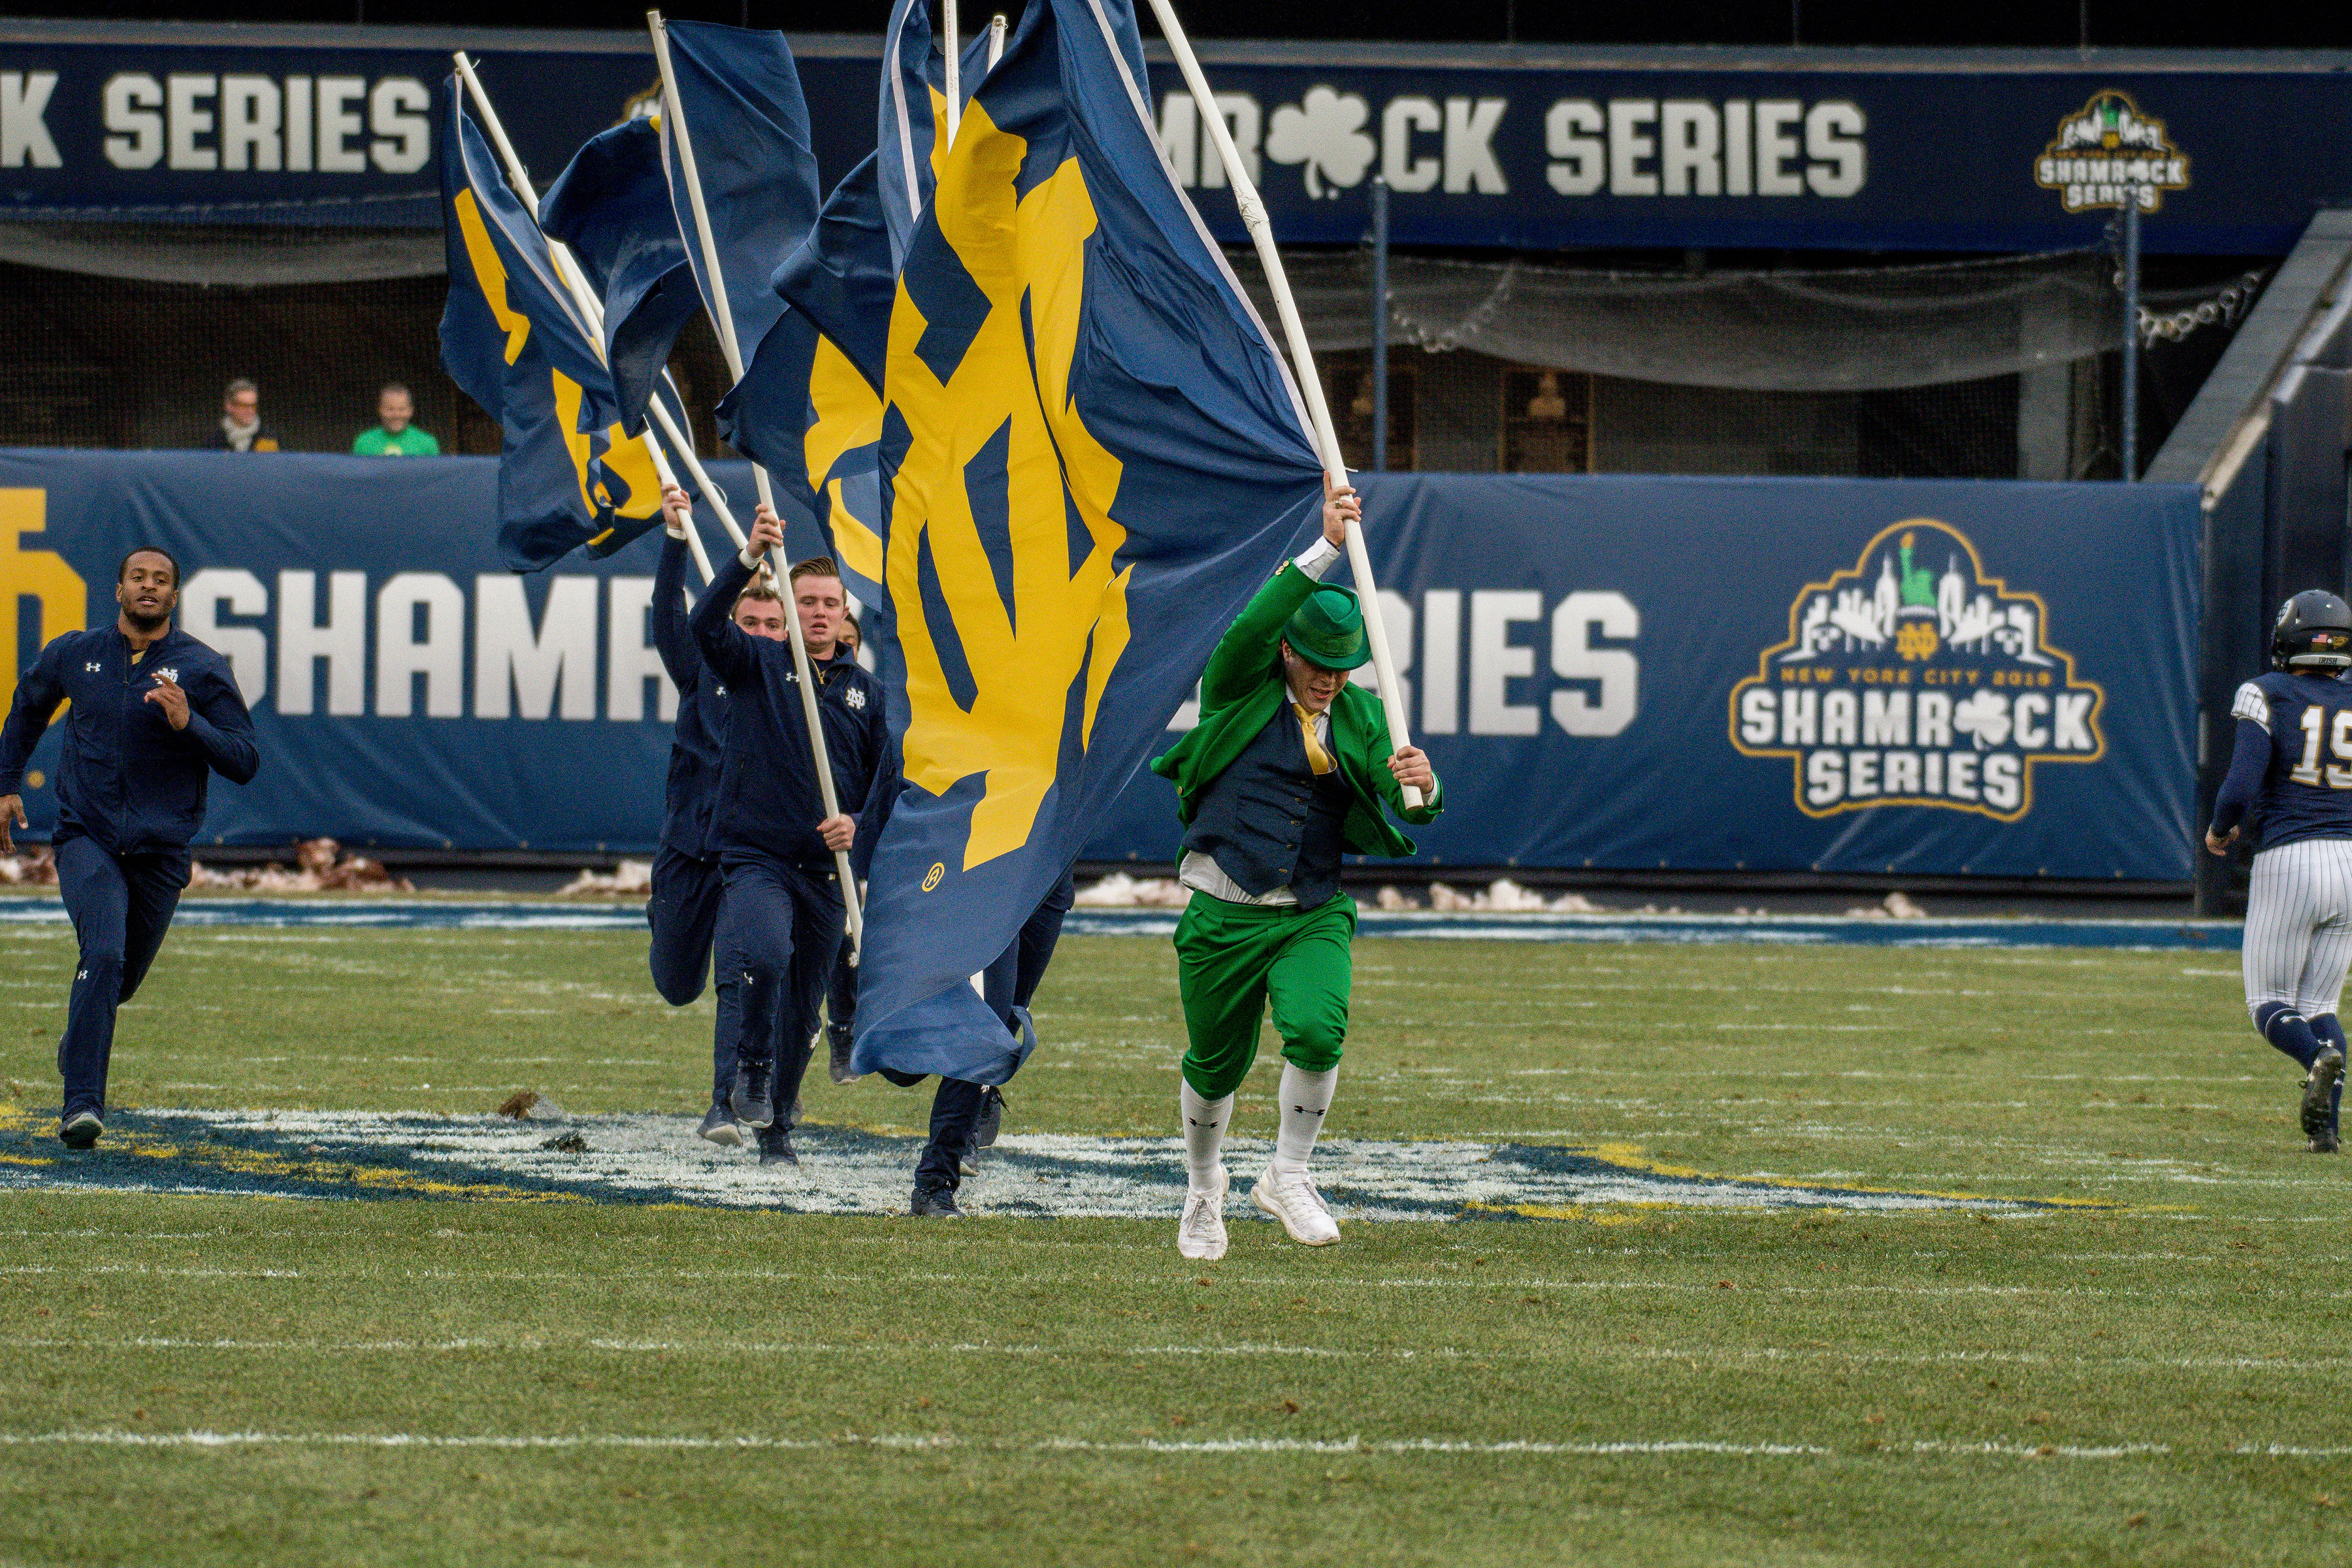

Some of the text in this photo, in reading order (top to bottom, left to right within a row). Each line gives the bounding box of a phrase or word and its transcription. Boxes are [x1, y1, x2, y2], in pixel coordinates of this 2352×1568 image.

[103, 72, 431, 174] SERIES
[1545, 100, 1867, 197] SERIES
[1780, 667, 1833, 683] NEW
[1847, 668, 1910, 684] YORK
[1923, 668, 1980, 685] CITY
[1806, 750, 2021, 809] SERIES
[2289, 705, 2352, 789] 19
